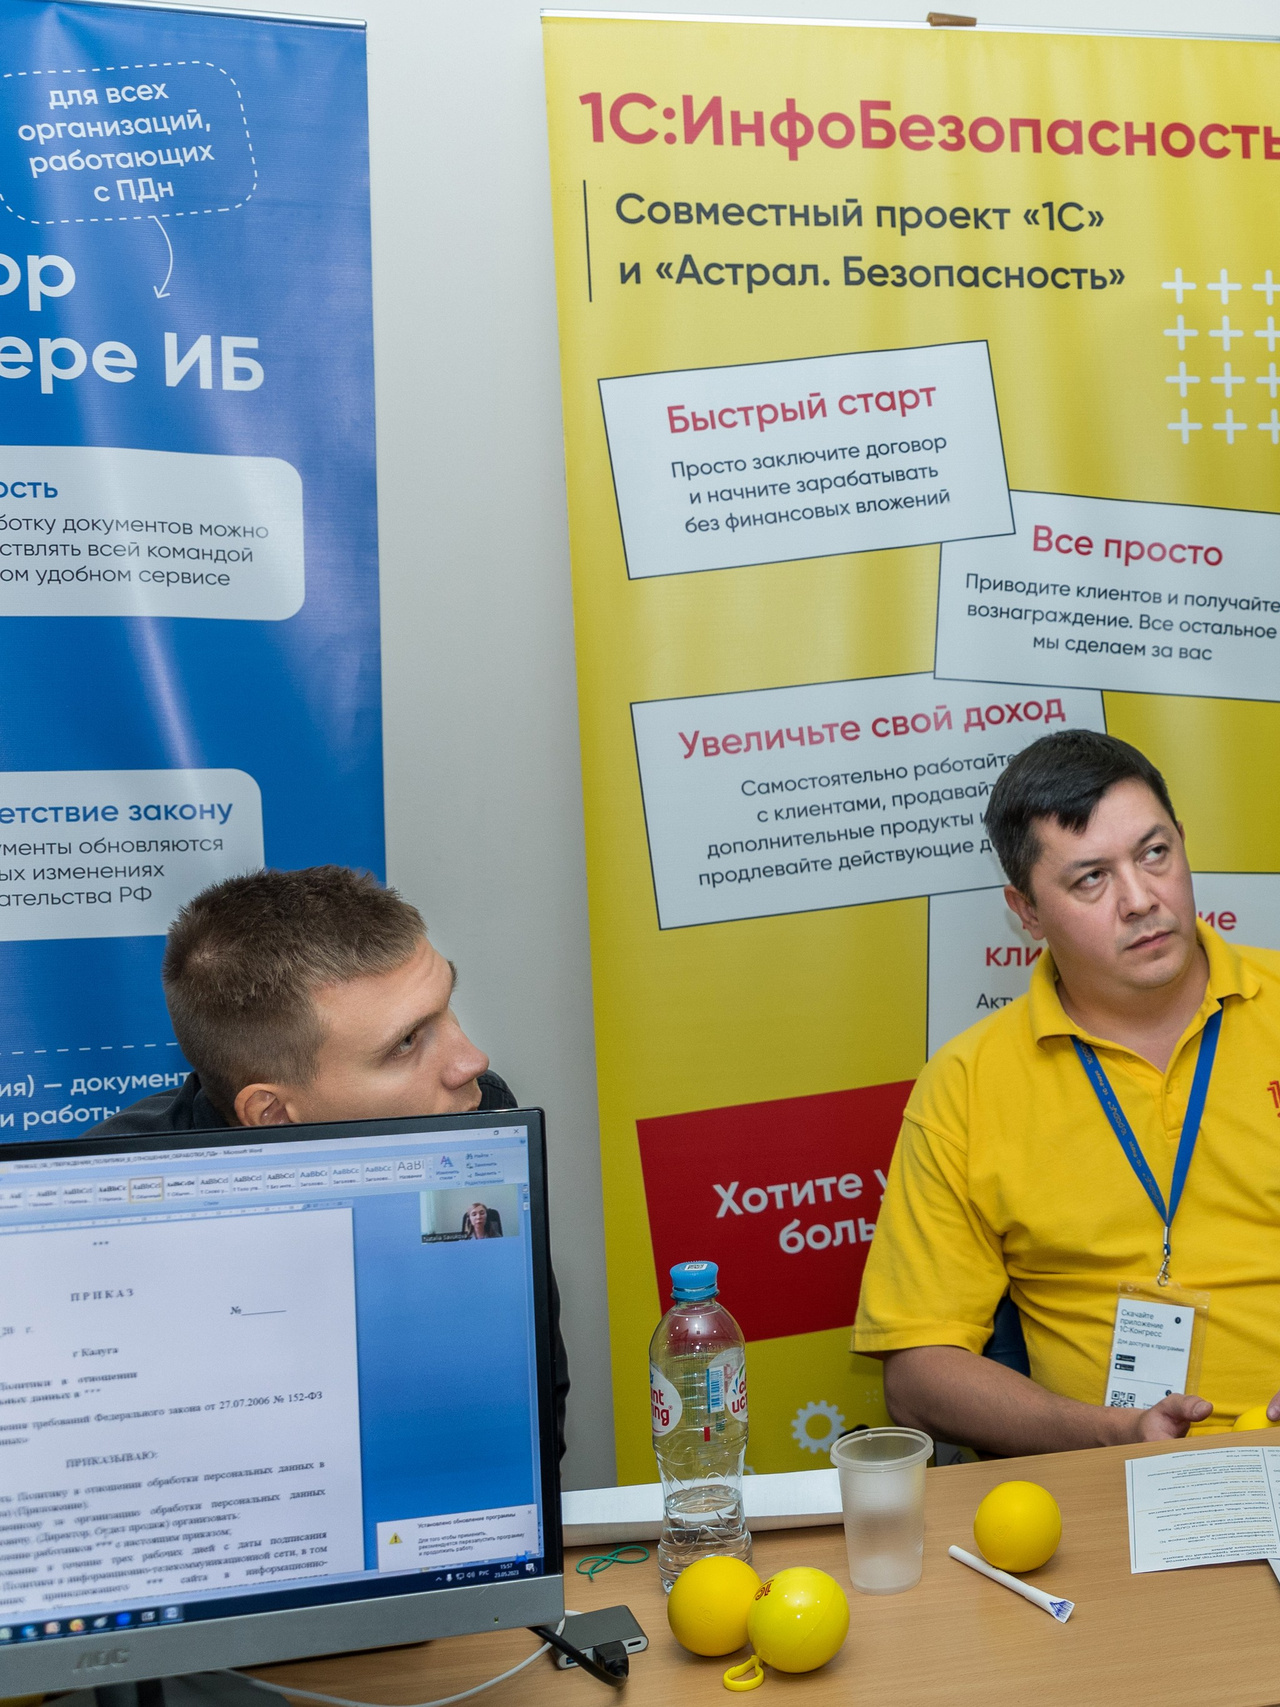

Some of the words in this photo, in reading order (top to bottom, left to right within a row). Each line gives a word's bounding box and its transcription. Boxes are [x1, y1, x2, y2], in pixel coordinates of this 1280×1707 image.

[49, 87, 98, 109] для
[106, 82, 169, 104] всех
[18, 109, 211, 144] организаций,
[29, 144, 215, 178] работающих
[94, 185, 110, 202] с
[116, 177, 174, 204] ПДн
[615, 192, 863, 227] Совместный
[876, 205, 1010, 236] проект
[1023, 201, 1105, 232] «1С»
[619, 262, 641, 284] и
[656, 254, 830, 294] «Астрал.
[843, 256, 1126, 290] Безопасность»
[164, 332, 265, 392] ИБ
[666, 392, 828, 434] Быстрый
[838, 386, 937, 418] старт
[671, 457, 747, 480] Просто
[753, 444, 860, 471] заключите
[866, 436, 947, 459] договор
[690, 491, 701, 504] и
[707, 481, 791, 504] начните
[797, 464, 939, 494] зарабатывать
[685, 517, 720, 533] без
[725, 500, 851, 532] финансовых
[856, 488, 950, 514] вложений
[63, 518, 193, 536] документов
[200, 523, 269, 539] можно
[0, 544, 81, 556] ствлять
[88, 541, 140, 557] всей
[147, 547, 253, 563] командой
[1033, 524, 1094, 556] Все
[1104, 538, 1223, 566] просто
[0, 569, 28, 582] ом
[36, 566, 131, 585] удобном
[139, 568, 230, 587] сервисе
[966, 573, 1071, 597] Приводите
[1076, 583, 1162, 604] клиентов
[1168, 593, 1178, 605] и
[967, 603, 1133, 629] вознаграждение.
[1139, 614, 1174, 631] Все
[1179, 619, 1278, 640] остальное
[1033, 636, 1059, 649] мы
[1065, 636, 1146, 657] сделаем
[1151, 645, 1173, 658] за
[1179, 646, 1213, 661] вас
[679, 719, 861, 760] Увеличьте
[871, 706, 952, 739] свой
[963, 698, 1066, 733] доход
[741, 765, 908, 797] Самостоятельно
[129, 803, 233, 825] закону
[757, 809, 769, 823] с
[774, 796, 887, 822] клиентами,
[0, 842, 72, 855] менты
[79, 838, 223, 854] обновляются
[707, 824, 875, 860] дополнительные
[880, 813, 974, 838] продукты
[33, 865, 165, 881] изменениях
[698, 857, 832, 888] продлевайте
[838, 840, 974, 871] действующие
[120, 886, 152, 902] РФ
[976, 993, 1013, 1009] Акт
[1, 1113, 14, 1127] и
[712, 1173, 863, 1219] Хотите
[1120, 1318, 1164, 1329] приложение
[1121, 1309, 1154, 1320] Скачайте
[81, 1346, 118, 1358] Калуга
[94, 1407, 165, 1422] Федерального
[169, 1405, 201, 1415] закона
[205, 1403, 216, 1411] от
[219, 1397, 270, 1410] 27.07.2006
[288, 1391, 323, 1403] 152-ФЗ
[147, 1475, 199, 1489] обработки
[204, 1467, 273, 1482] персональных
[278, 1462, 314, 1474] данных
[151, 1502, 202, 1516] обработки
[211, 1493, 280, 1508] персональных
[289, 1488, 326, 1500] данных
[238, 1539, 262, 1549] даты
[270, 1531, 327, 1545] подписания
[310, 1546, 328, 1554] том
